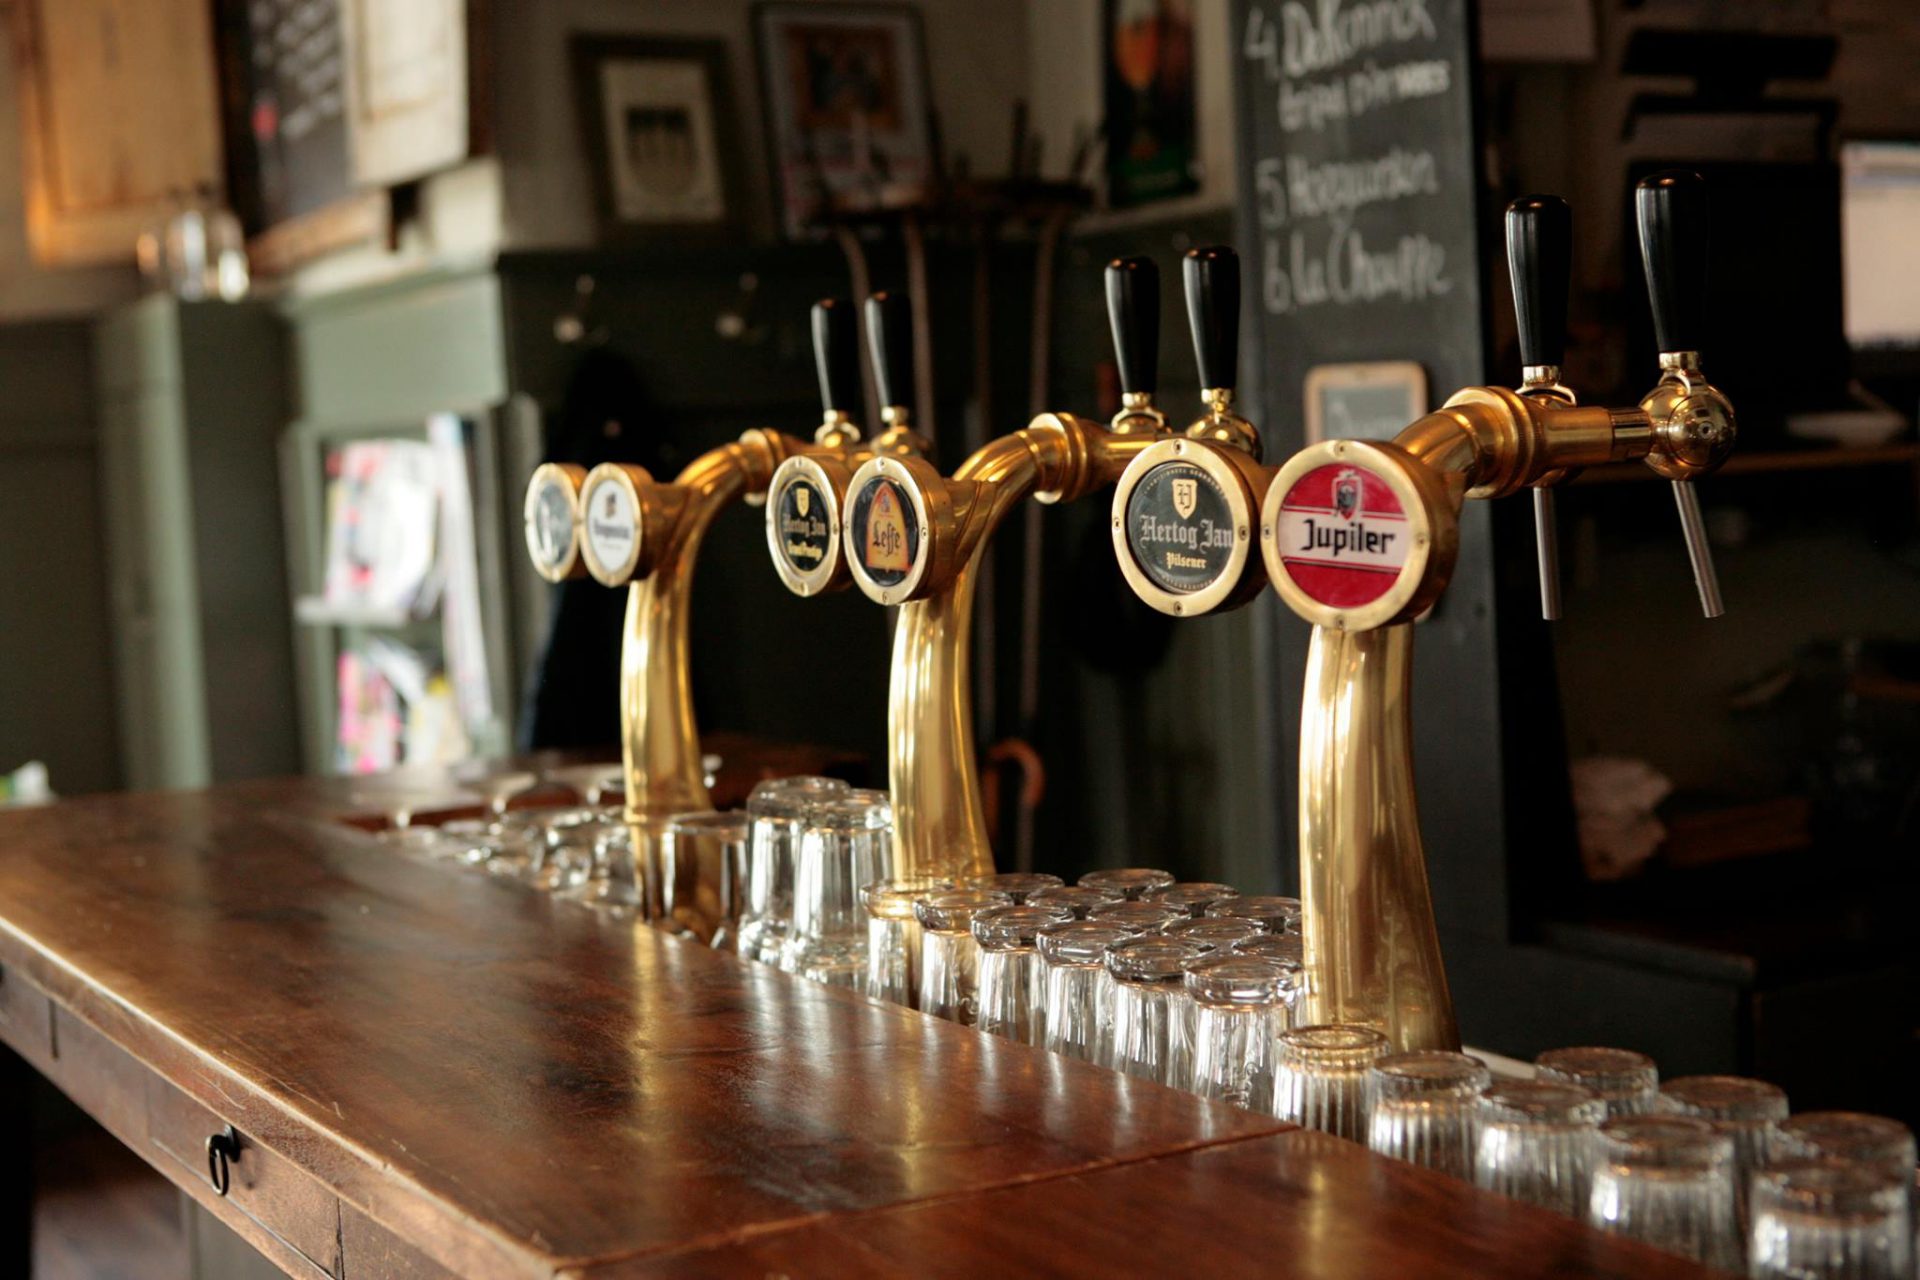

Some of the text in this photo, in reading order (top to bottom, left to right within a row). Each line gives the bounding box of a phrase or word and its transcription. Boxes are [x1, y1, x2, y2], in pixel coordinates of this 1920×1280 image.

[1255, 157, 1286, 229] 5
[872, 520, 901, 557] Leffe
[1139, 514, 1234, 554] Hertog Jan
[1301, 519, 1396, 557] Jupiler
[1166, 552, 1207, 569] Pilsener
